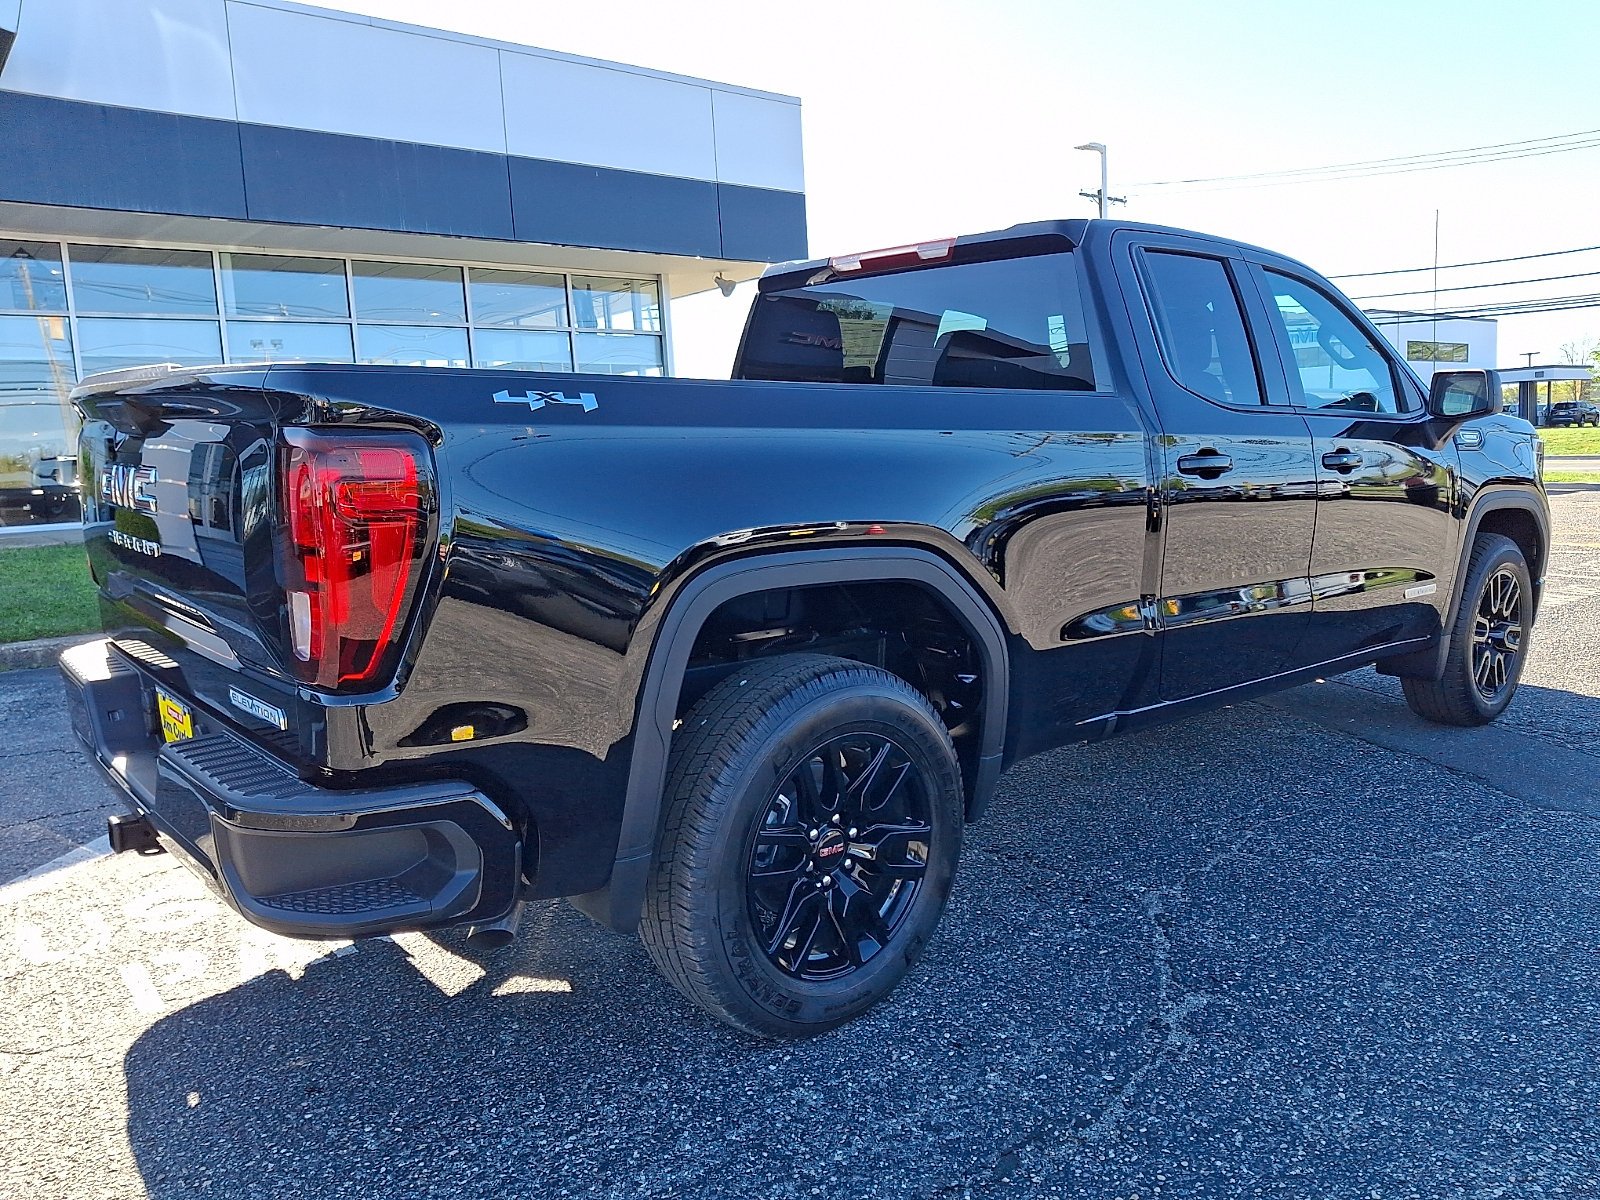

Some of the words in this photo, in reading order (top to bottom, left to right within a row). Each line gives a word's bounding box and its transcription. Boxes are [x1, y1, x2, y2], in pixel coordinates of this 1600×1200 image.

[101, 464, 158, 515] GMC
[231, 692, 279, 724] ELEVATION
[819, 843, 844, 858] GMC
